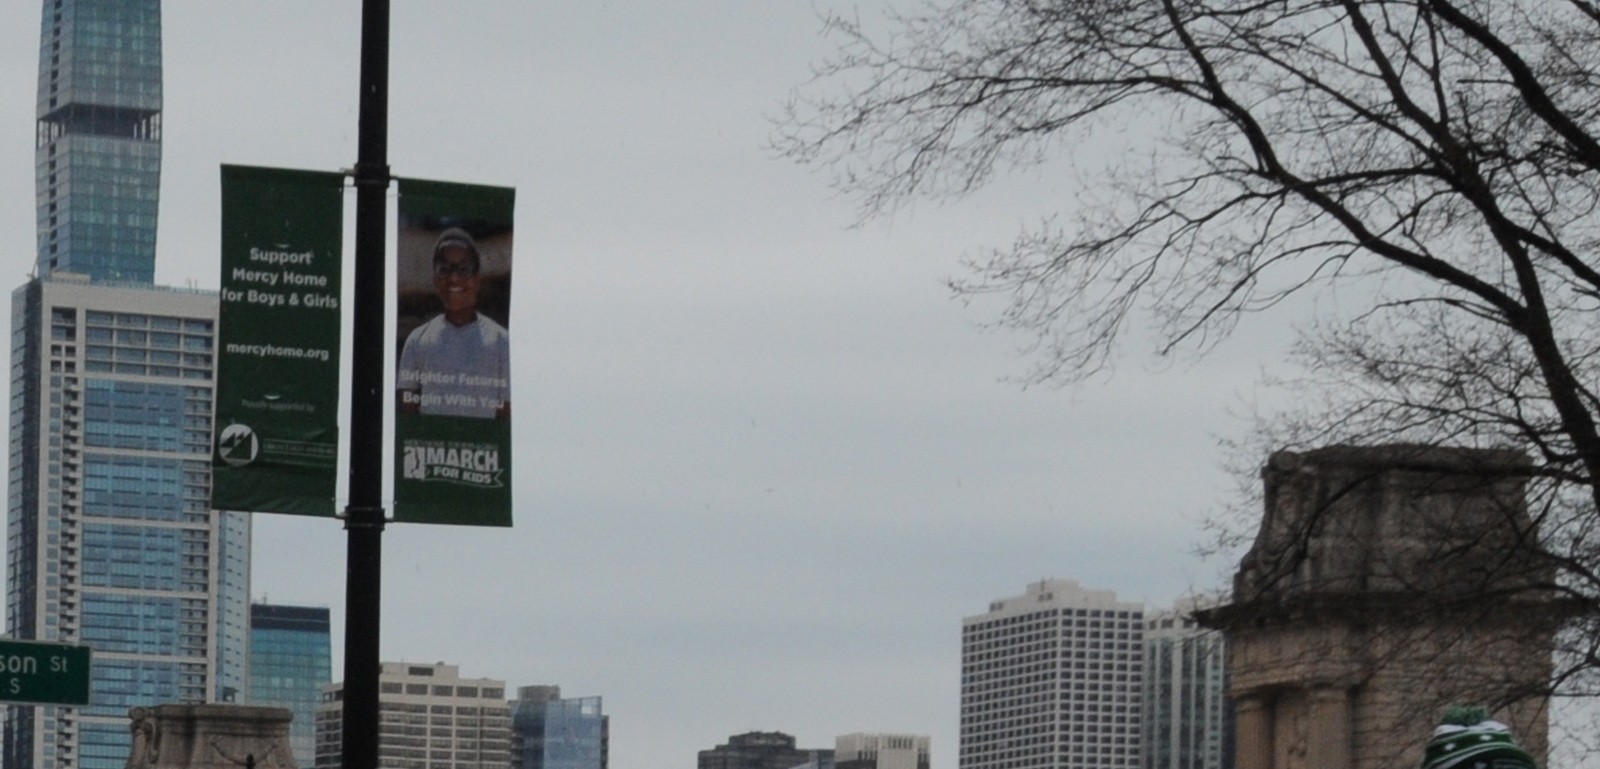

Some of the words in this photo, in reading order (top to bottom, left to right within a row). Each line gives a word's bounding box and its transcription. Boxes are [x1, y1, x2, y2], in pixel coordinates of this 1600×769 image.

[250, 247, 312, 265] Support
[232, 267, 279, 286] Mercy
[283, 270, 327, 287] Home
[221, 287, 243, 302] for
[247, 289, 285, 307] Boys
[288, 292, 299, 306] &
[303, 293, 338, 309] Girls
[226, 343, 329, 361] mercyhome.org
[400, 369, 456, 385] Brighter
[460, 373, 508, 387] Futures
[403, 391, 441, 406] Begin
[445, 394, 476, 407] With
[480, 397, 504, 409] You
[426, 447, 498, 472] MARCH
[433, 466, 459, 479] FOR
[462, 470, 492, 484] KIDS
[50, 656, 67, 673] St
[10, 677, 20, 694] S
